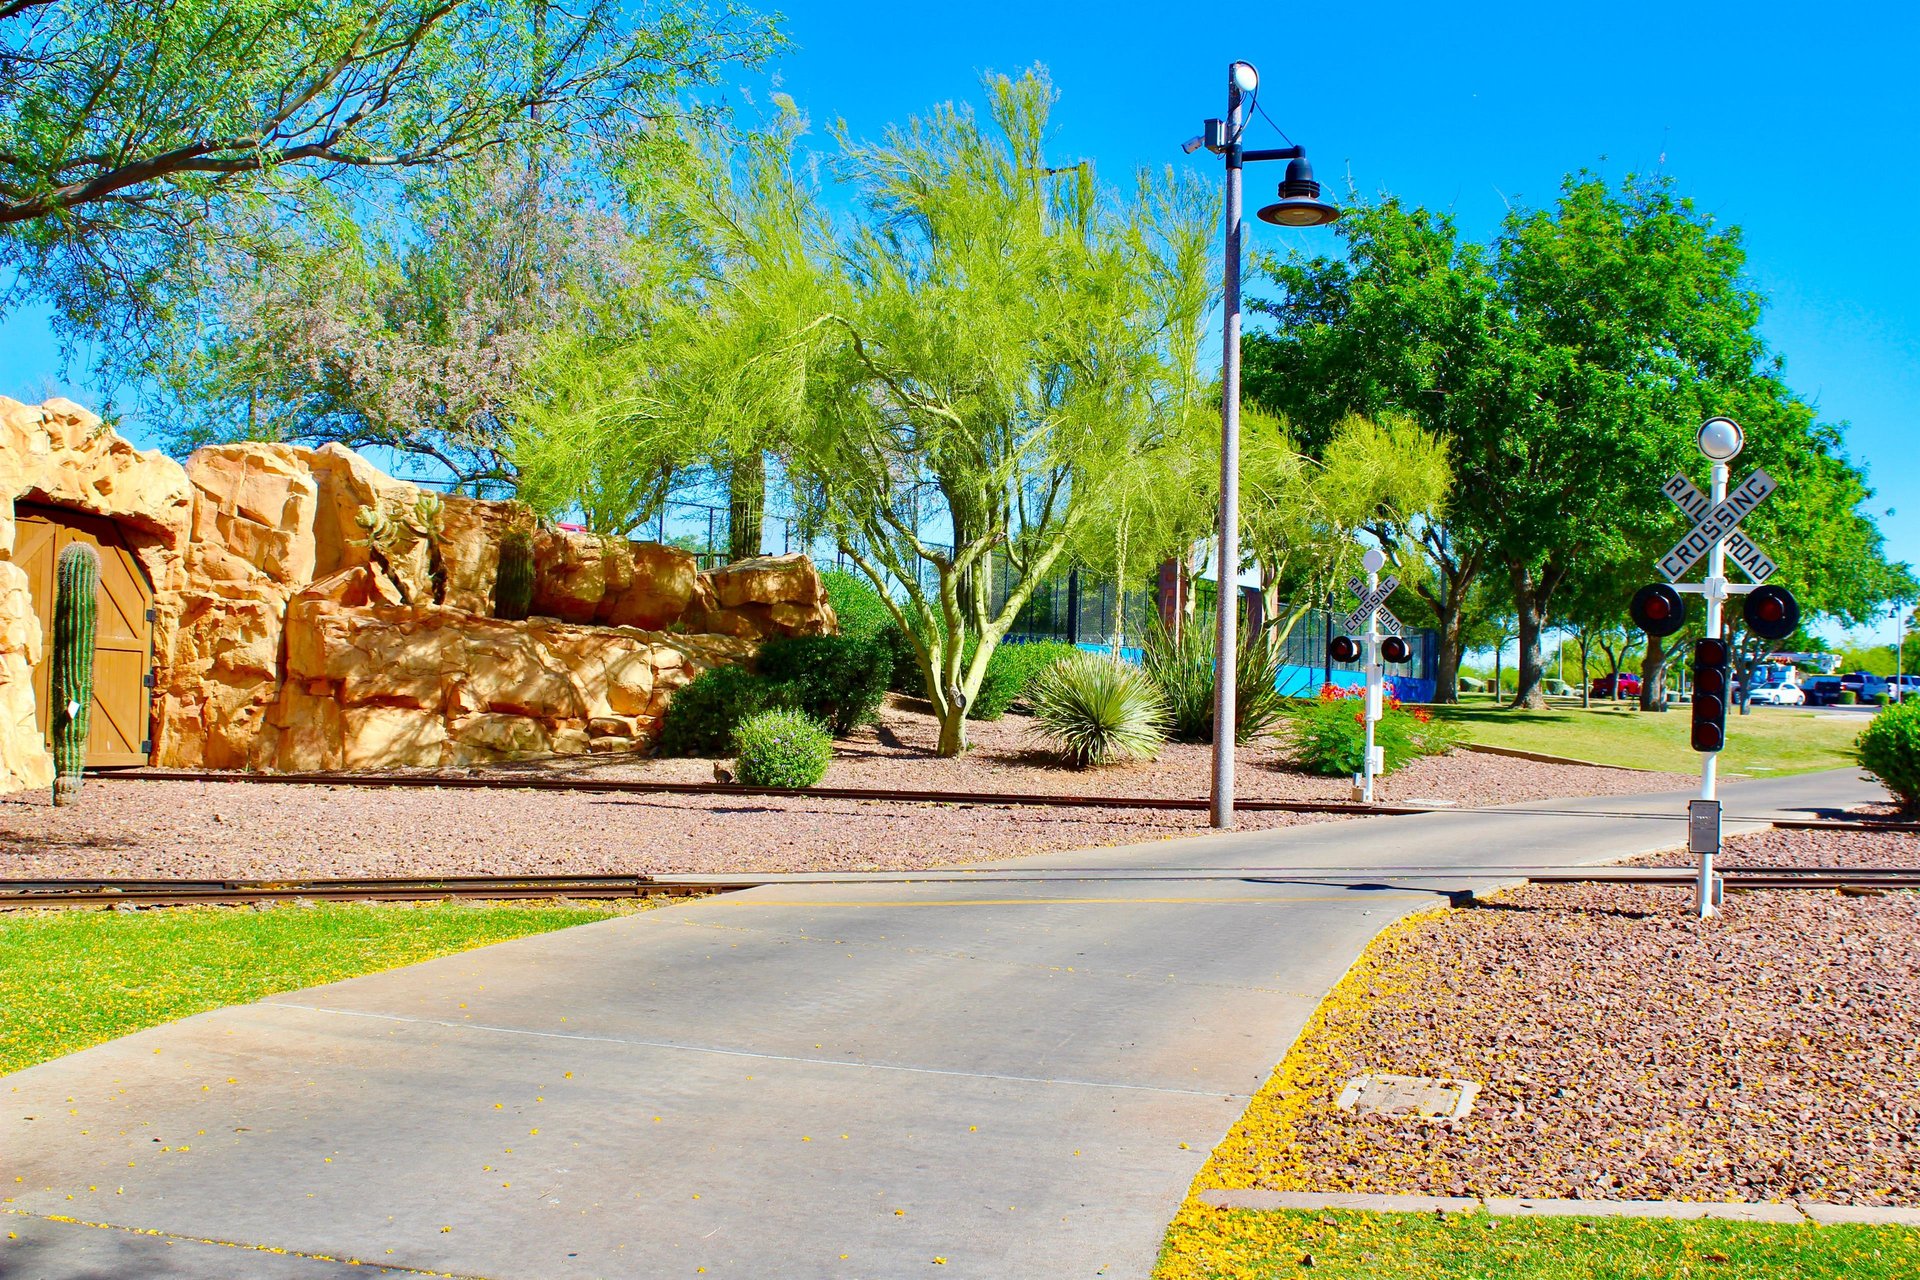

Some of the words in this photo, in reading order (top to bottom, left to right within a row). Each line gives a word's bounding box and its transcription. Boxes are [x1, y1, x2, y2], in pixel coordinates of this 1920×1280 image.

[1661, 478, 1768, 577] CROSSING
[1666, 478, 1710, 522] RAIL
[1724, 532, 1773, 580] ROAD
[1345, 579, 1396, 631] CROSSING
[1348, 577, 1370, 601] RAIL
[1376, 607, 1400, 632] ROAD
